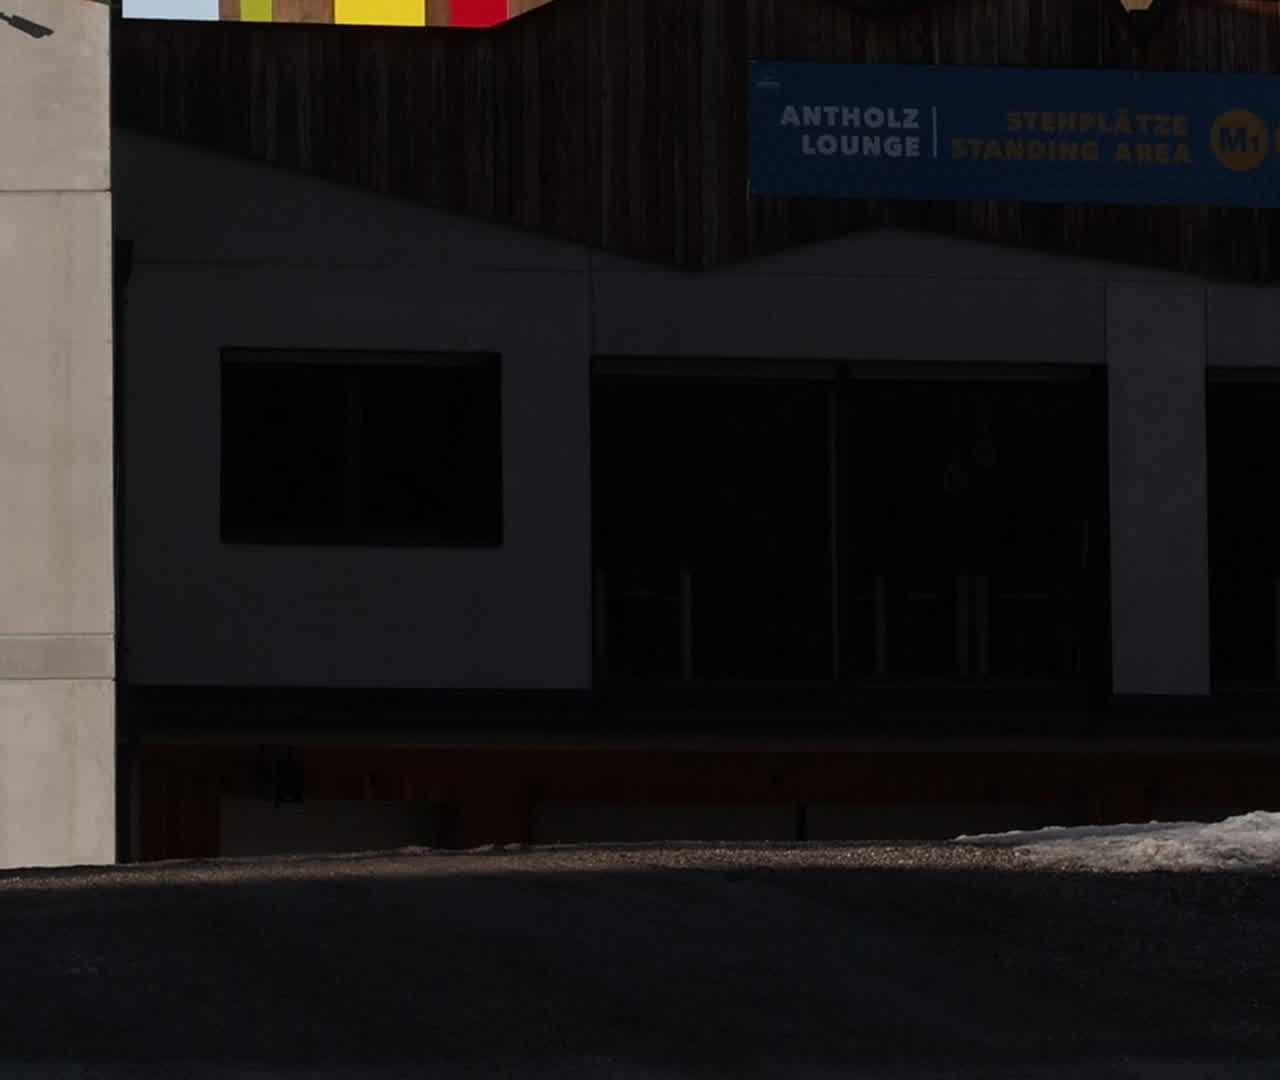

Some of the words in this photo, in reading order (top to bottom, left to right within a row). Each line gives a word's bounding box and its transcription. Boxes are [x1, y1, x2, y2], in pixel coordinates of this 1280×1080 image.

[780, 104, 921, 129] ANTHOLZ
[801, 135, 921, 158] LOUNGE
[951, 137, 1099, 161] STANDING
[1113, 142, 1192, 165] AREA
[1220, 127, 1260, 153] M1
